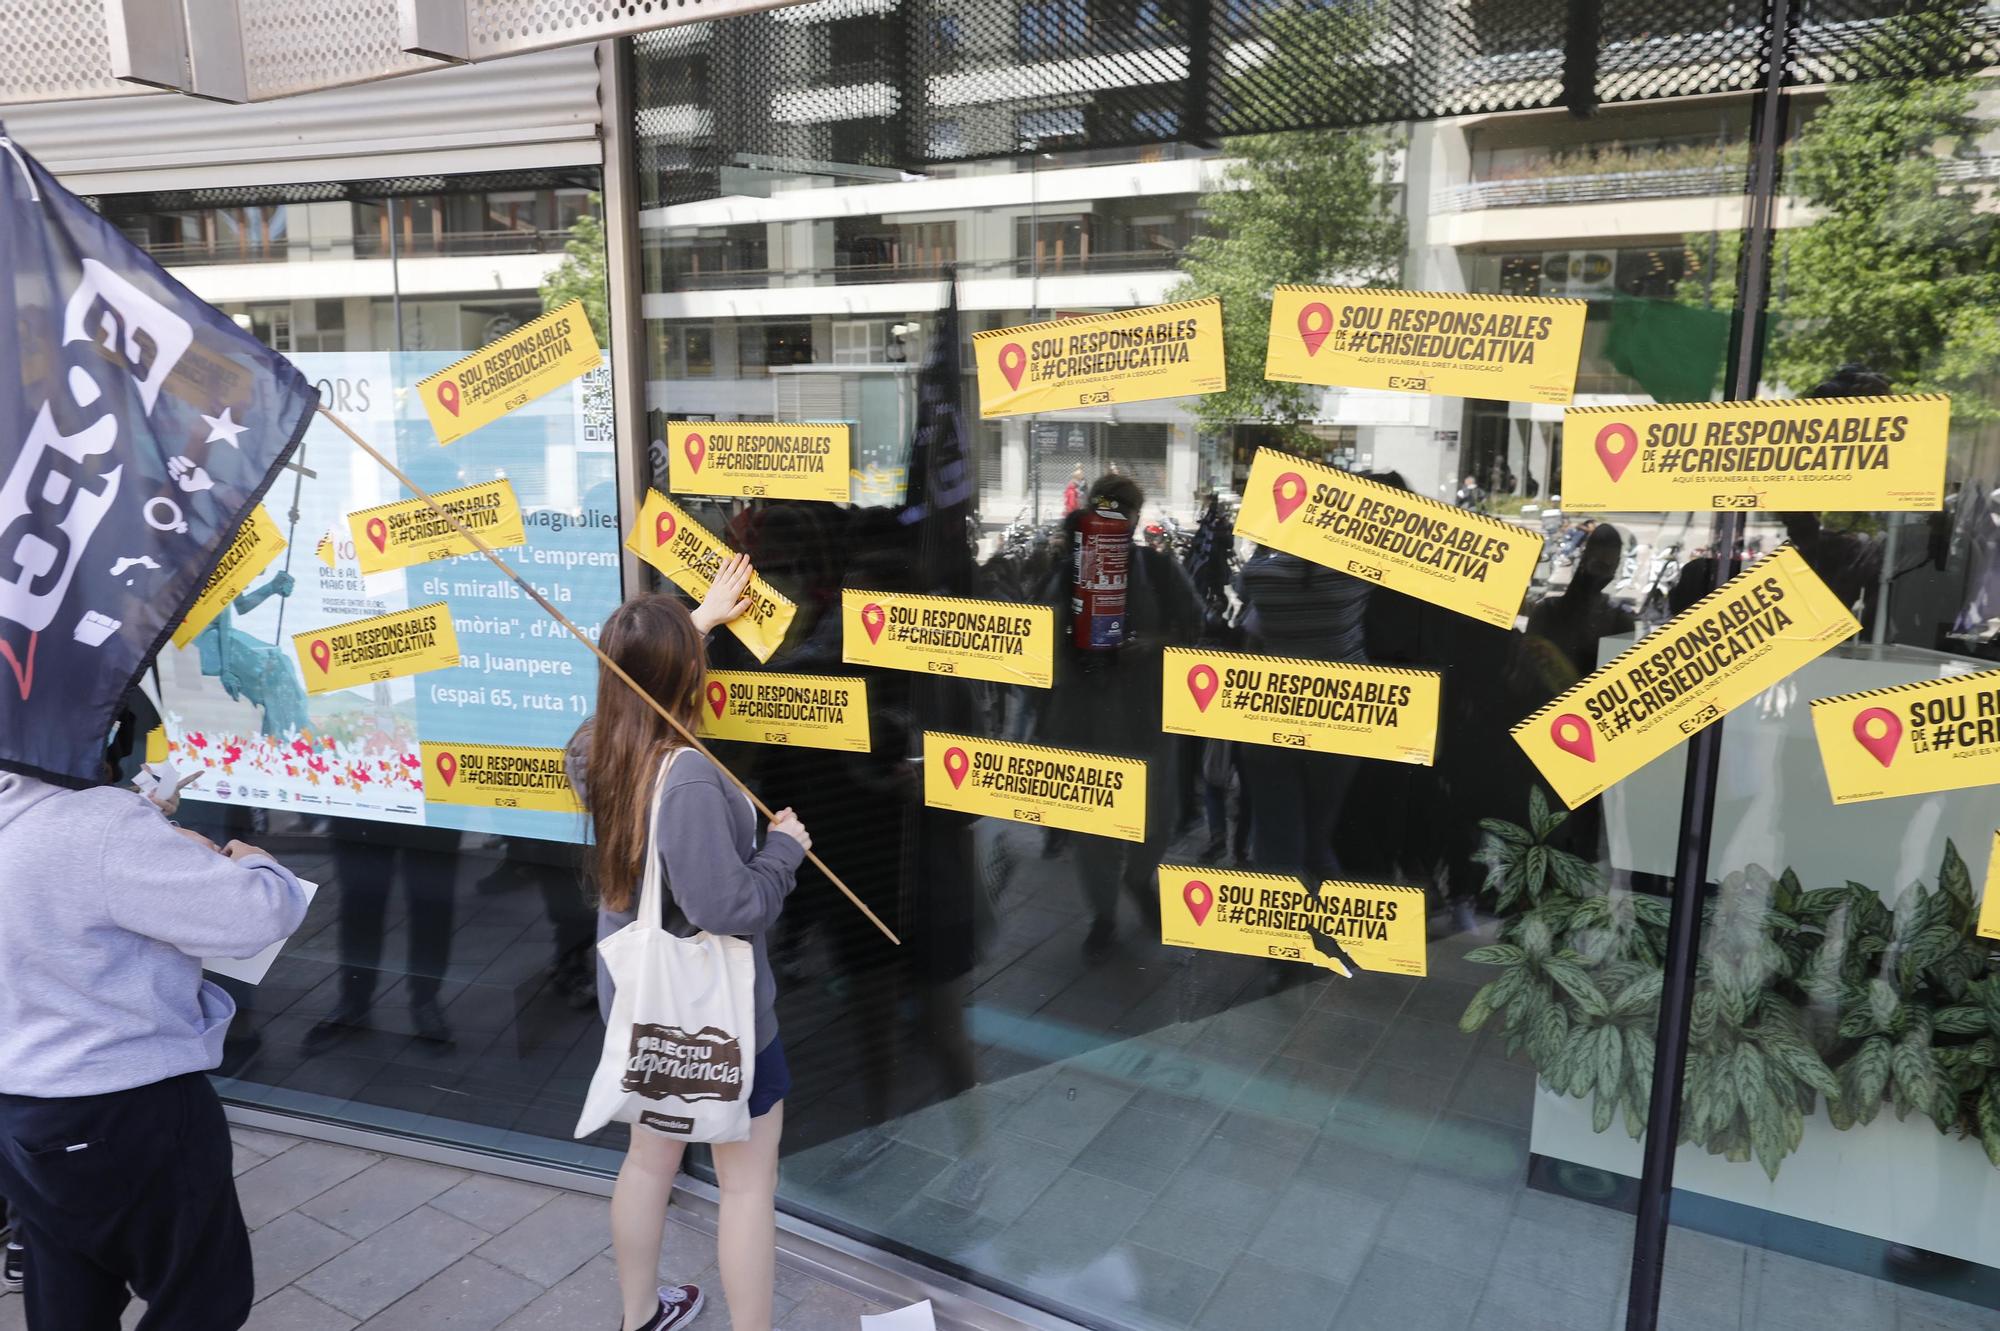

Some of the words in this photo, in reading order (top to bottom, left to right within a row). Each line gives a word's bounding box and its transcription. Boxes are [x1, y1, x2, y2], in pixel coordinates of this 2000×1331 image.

[1335, 329, 1348, 341] DE
[1339, 305, 1384, 330] SOU
[1386, 308, 1553, 341] RESPONSABLES
[1030, 337, 1064, 361] SOU
[1068, 318, 1197, 356] RESPONSABLES
[1333, 340, 1346, 352] LA
[1347, 330, 1535, 365] #CRISIEDUCATIVA
[458, 363, 483, 390] SOU
[483, 317, 572, 377] RESPONSABLES
[1041, 341, 1190, 381] #CRISIEDUCATIVA
[1387, 358, 1421, 366] VULNERA
[1431, 361, 1452, 369] DRET
[471, 336, 573, 402] #CRISIEDUCATIVA
[708, 434, 734, 452] SOU
[736, 435, 831, 455] RESPONSABLES
[1645, 422, 1698, 449] SOU
[1703, 415, 1909, 447] RESPONSABLES
[715, 452, 824, 473] #CRISIEDUCATIVA
[1641, 461, 1656, 474] LA
[1642, 449, 1657, 462] DE
[1657, 444, 1889, 473] #CRISIEDUCATIVA
[1707, 475, 1749, 483] VULNERA
[1762, 475, 1787, 483] DRET
[388, 511, 412, 531] SOU
[1302, 513, 1315, 526] LA
[1305, 503, 1319, 516] DE
[1311, 483, 1356, 513] SOU
[1354, 497, 1510, 564] RESPONSABLES
[678, 527, 702, 552] SOU
[1314, 509, 1489, 583] #CRISIEDUCATIVA
[1350, 542, 1381, 558] VULNERA
[1390, 556, 1410, 567] DRET
[320, 580, 344, 590] MAIG
[347, 581, 358, 590] DE
[423, 577, 449, 596] els
[453, 580, 519, 600] miralls
[554, 583, 571, 602] la
[330, 633, 354, 652] SOU
[355, 615, 437, 647] RESPONSABLES
[889, 605, 919, 626] SOU
[921, 608, 1032, 637] RESPONSABLES
[341, 631, 436, 666] #CRISIEDUCATIVA
[896, 625, 1023, 656] #CRISIEDUCATIVA
[1584, 679, 1629, 721] SOU
[1627, 577, 1785, 693] RESPONSABLES
[483, 651, 573, 678] Juanpere
[1612, 605, 1793, 734] #CRISIEDUCATIVA
[431, 683, 485, 708] (espai
[490, 689, 517, 710] 65,
[522, 694, 563, 711] ruta
[570, 695, 588, 716] 1)
[729, 683, 754, 701] SOU
[757, 684, 849, 708] RESPONSABLES
[1221, 688, 1233, 699] DE
[1223, 668, 1263, 691] SOU
[1266, 672, 1412, 707] RESPONSABLES
[737, 700, 844, 724] #CRISIEDUCATIVA
[1221, 698, 1232, 709] LA
[1233, 690, 1398, 728] #CRISIEDUCATIVA
[1909, 694, 1966, 728] SOU
[1595, 718, 1611, 733] DE
[1603, 728, 1619, 743] LA
[1910, 728, 1927, 742] DE
[1913, 741, 1930, 754] LA
[459, 754, 484, 770] SOU
[486, 755, 567, 776] RESPONSABL
[973, 751, 1004, 773] SOU
[1007, 756, 1124, 791] RESPONSABLES
[981, 771, 1114, 809] #CRISIEDUCATIVA
[1218, 884, 1255, 906] SOU
[1259, 888, 1398, 922] RESPONSABLES
[1228, 905, 1388, 942] #CRISIEDUCATIVA
